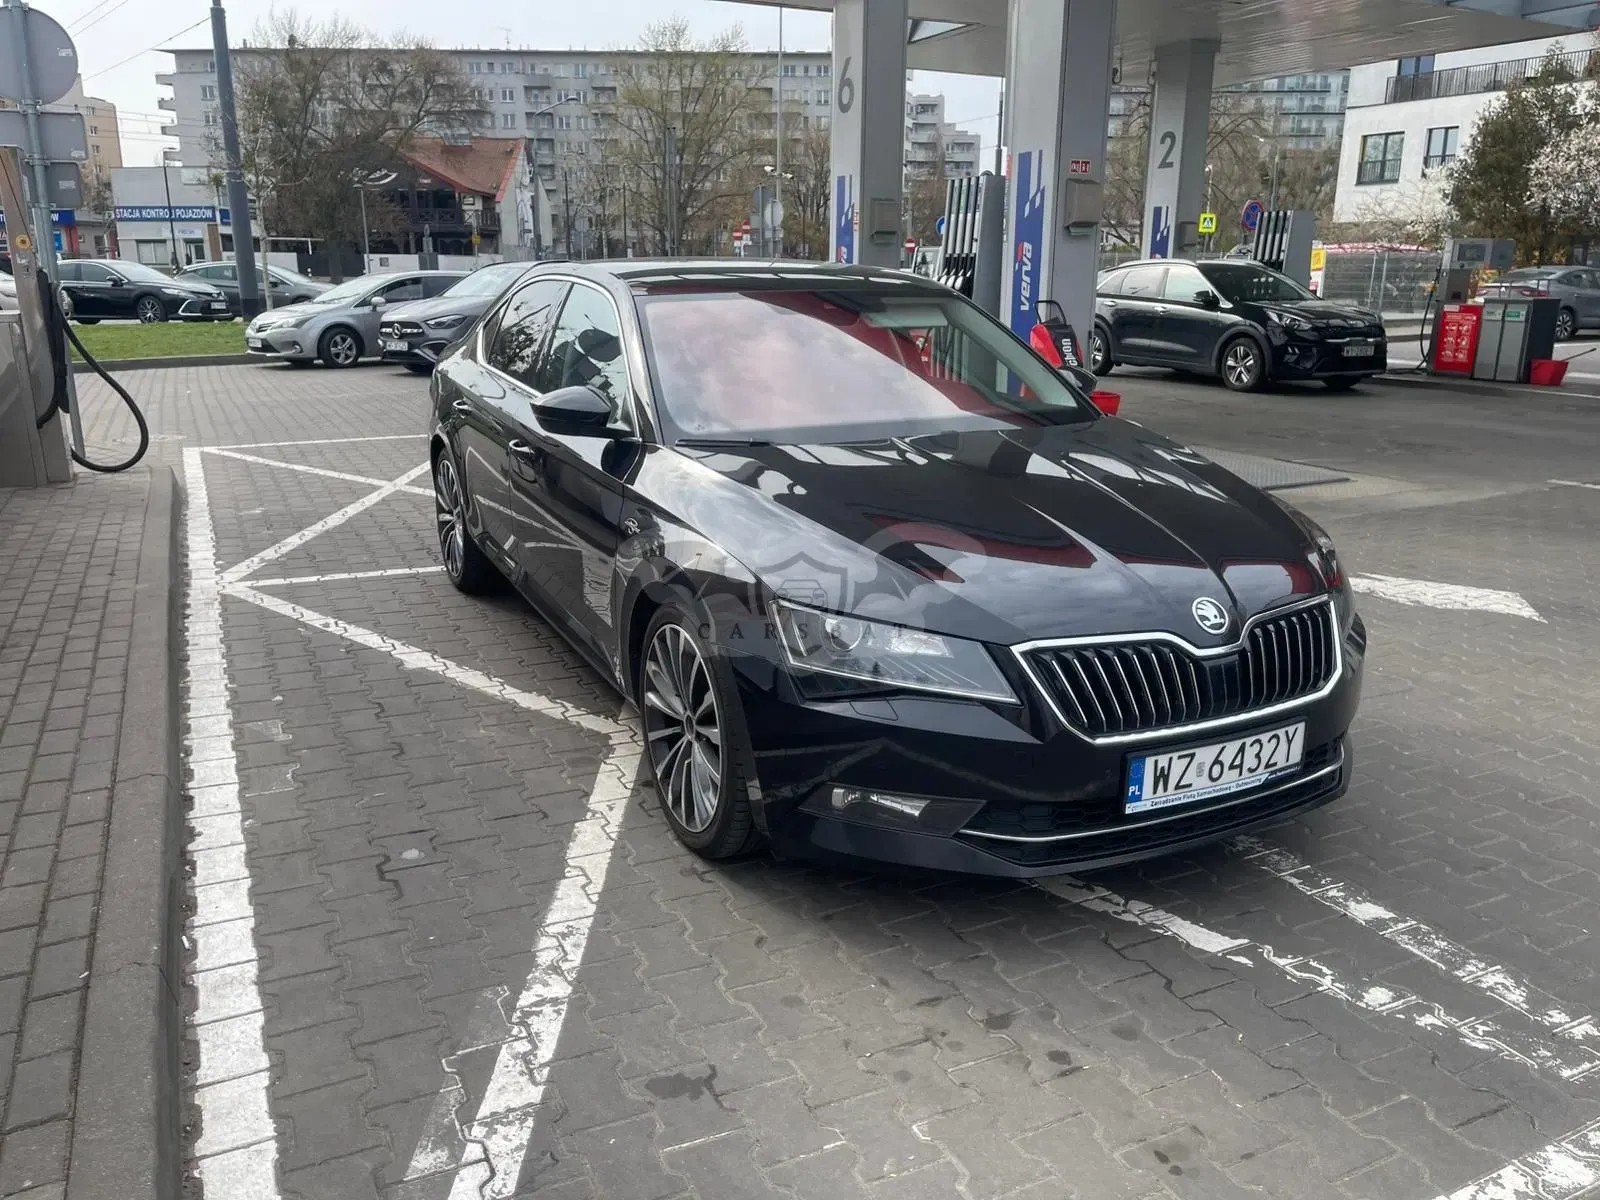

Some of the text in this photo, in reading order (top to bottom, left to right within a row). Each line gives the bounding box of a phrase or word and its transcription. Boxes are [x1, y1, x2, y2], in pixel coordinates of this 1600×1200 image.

[837, 56, 855, 114] 6
[1158, 131, 1177, 169] 2
[115, 208, 213, 219] STACJA KONTROI POJAZDÓW
[1020, 241, 1033, 311] verva
[1152, 726, 1299, 795] WZ 6432Y
[1128, 785, 1141, 797] PL
